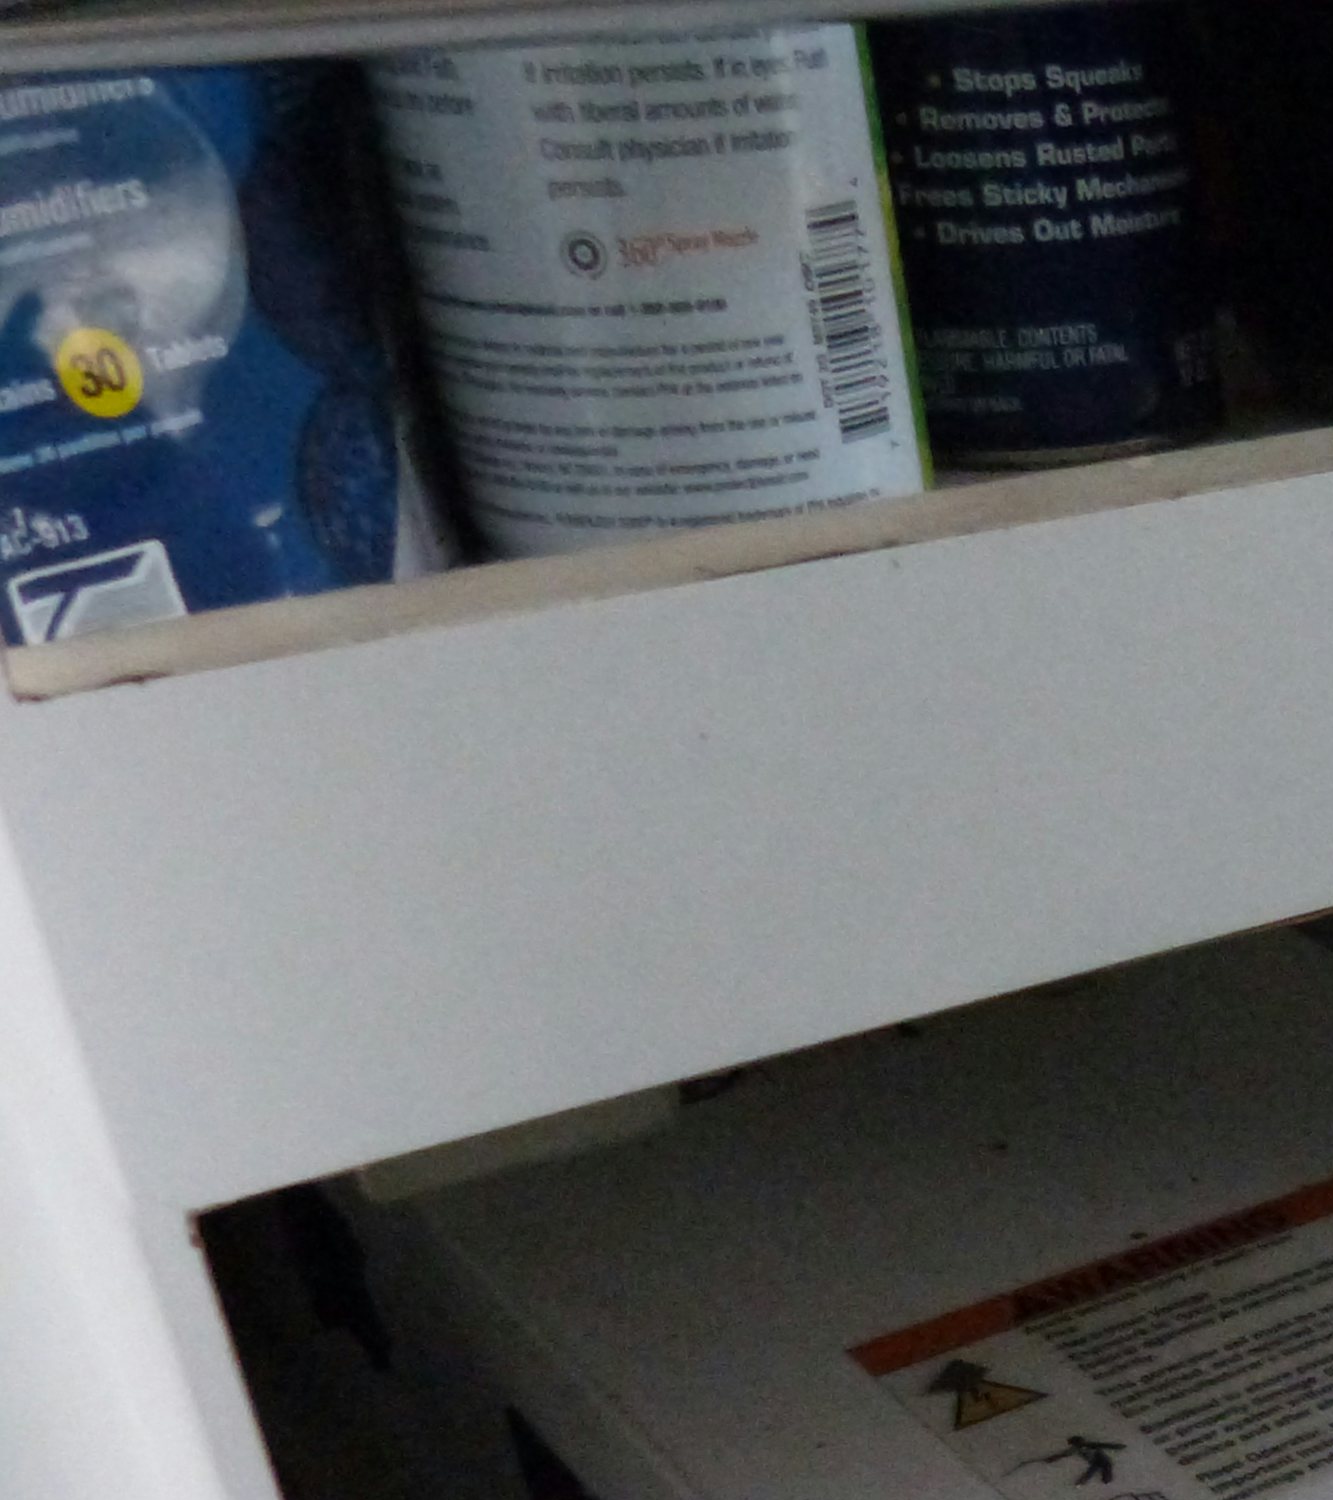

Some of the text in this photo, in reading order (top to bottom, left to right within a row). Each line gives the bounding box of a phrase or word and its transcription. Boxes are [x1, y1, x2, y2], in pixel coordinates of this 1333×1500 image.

[952, 60, 1037, 102] Stops
[919, 96, 1044, 139] Removes
[1053, 103, 1072, 127] &
[913, 137, 1026, 178] Loosens
[1036, 134, 1124, 168] Rusted
[980, 177, 1068, 215] Sticky
[936, 213, 1024, 252] Drives
[1032, 213, 1083, 244] Out
[68, 343, 127, 402] 30
[1035, 1203, 1294, 1307] WARNING
